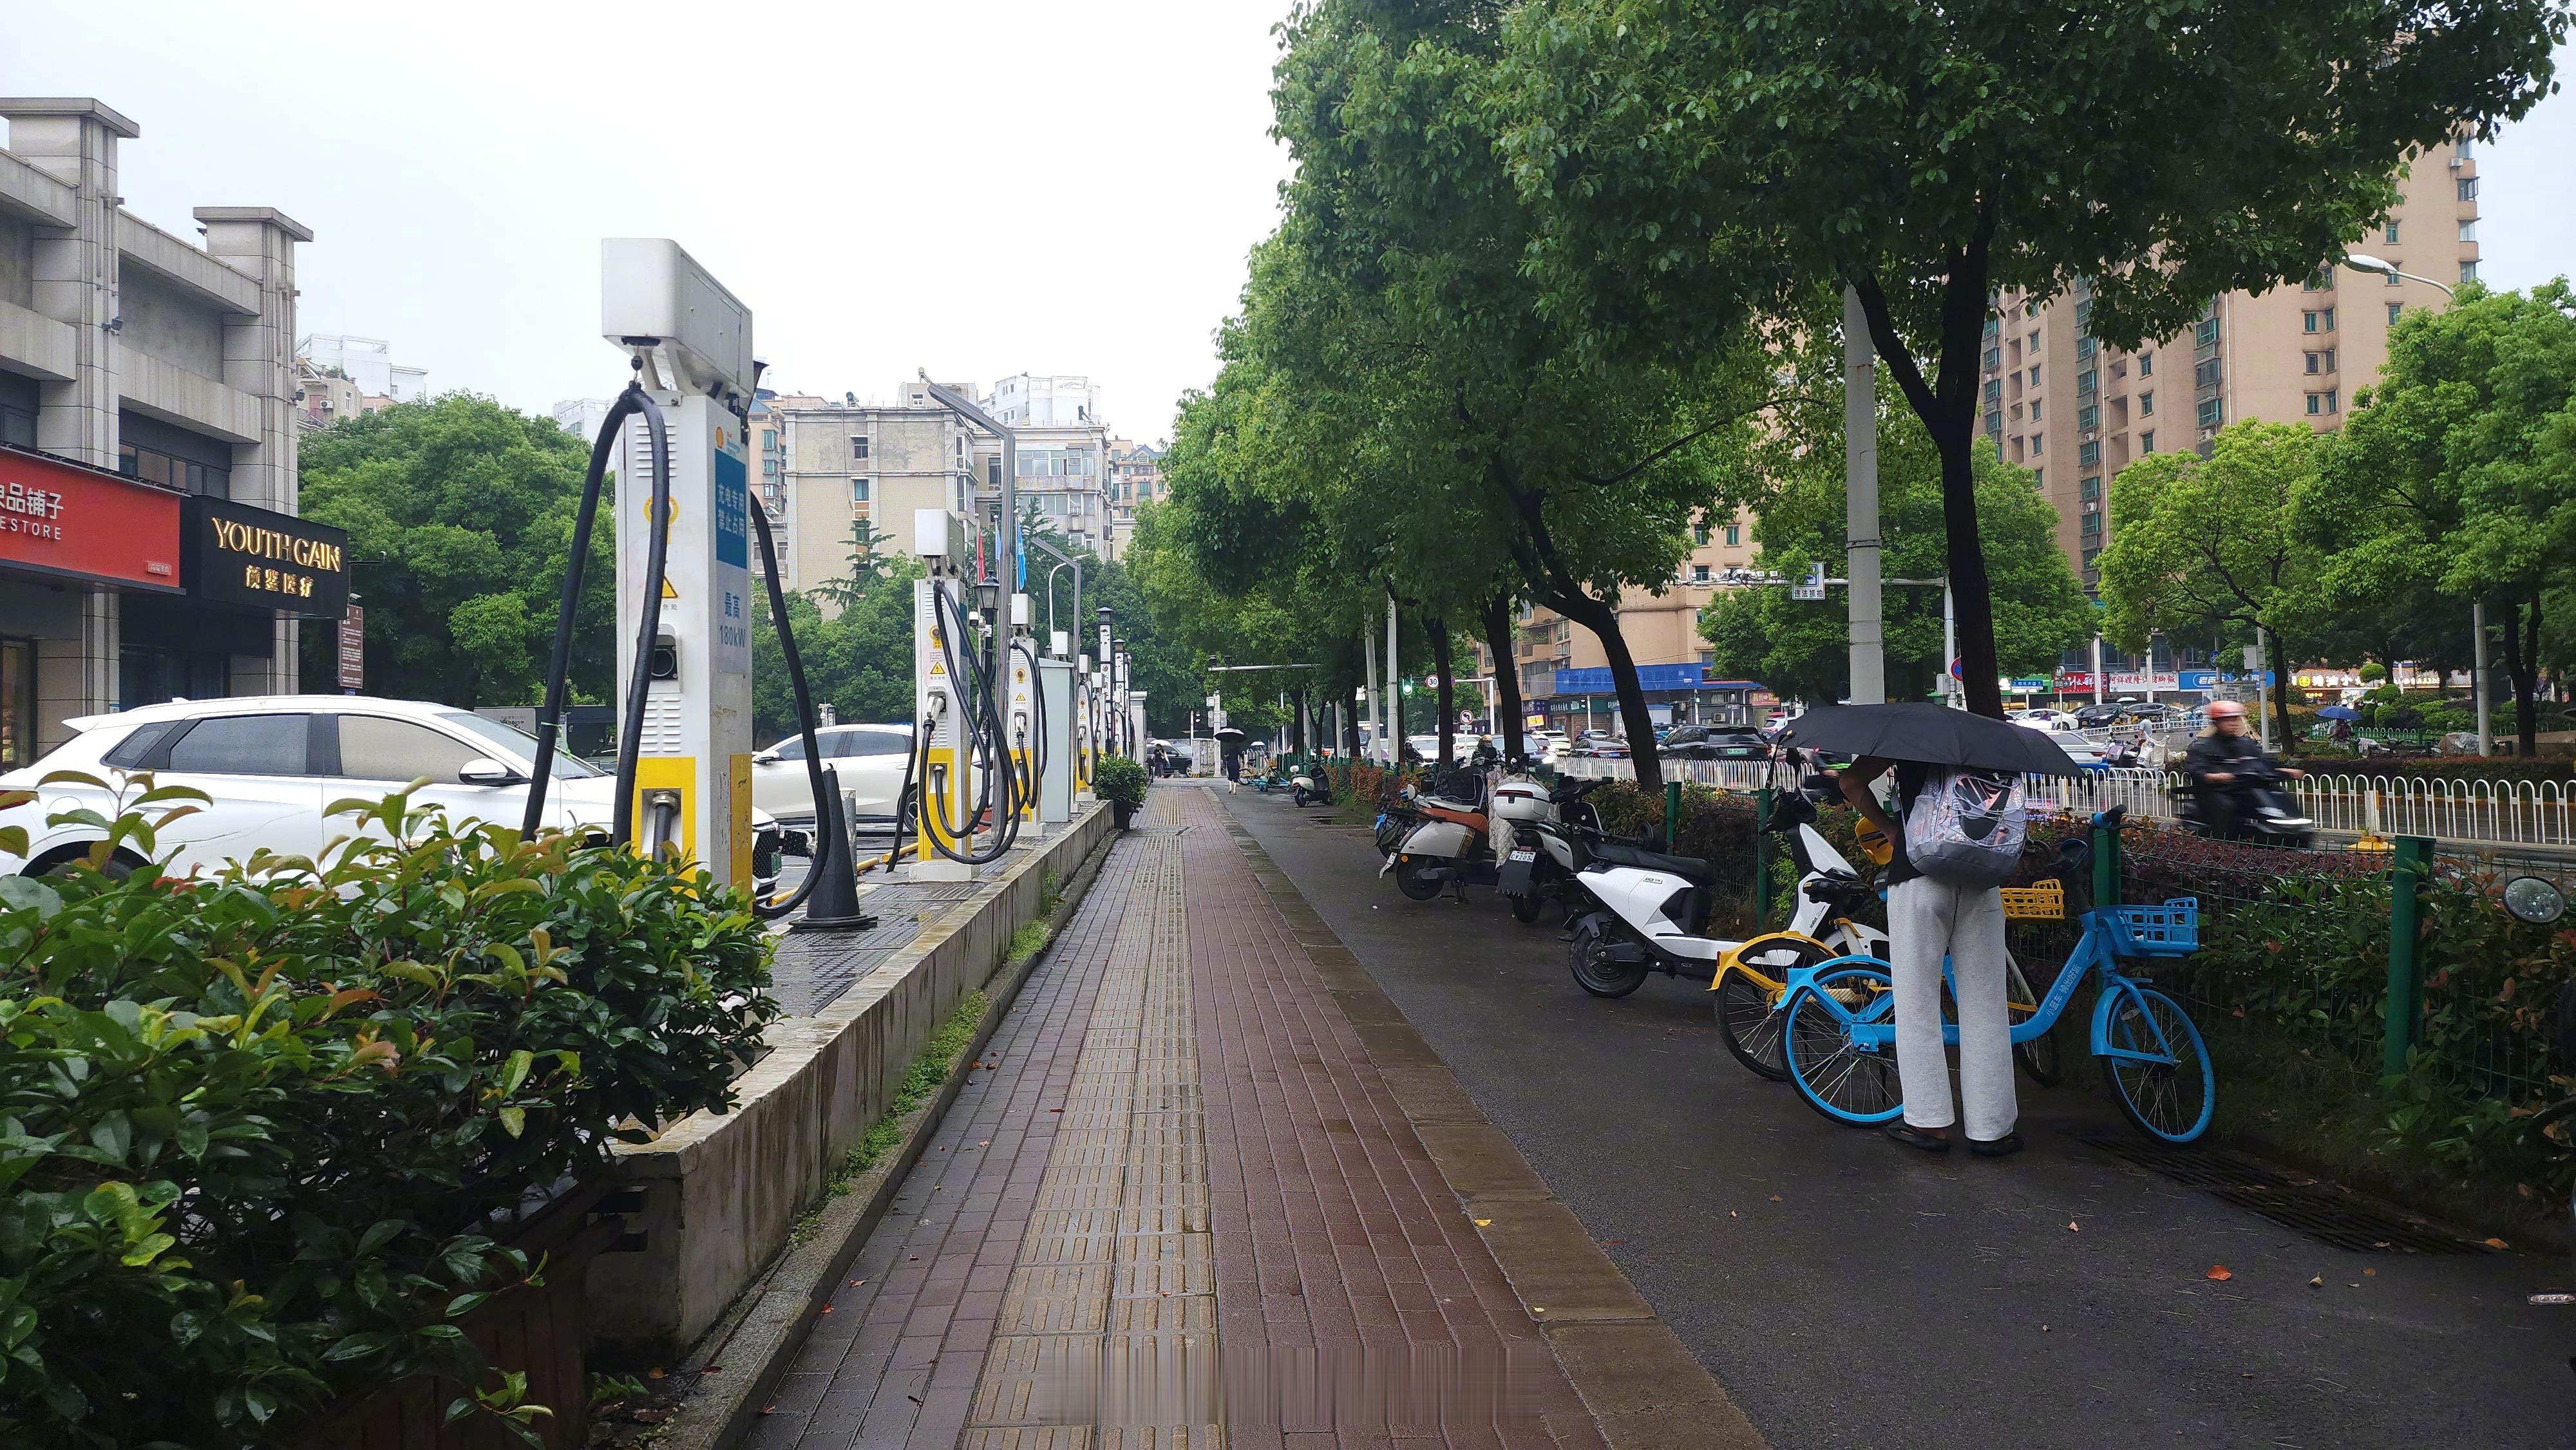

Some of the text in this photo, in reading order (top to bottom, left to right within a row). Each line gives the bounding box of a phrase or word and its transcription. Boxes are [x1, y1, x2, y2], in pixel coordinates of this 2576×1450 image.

[718, 483, 745, 513] 充电专用
[718, 508, 745, 538] 禁止占用
[724, 592, 740, 619] 最高
[1794, 588, 1823, 598] 违法抓拍
[720, 625, 746, 648] 180kW
